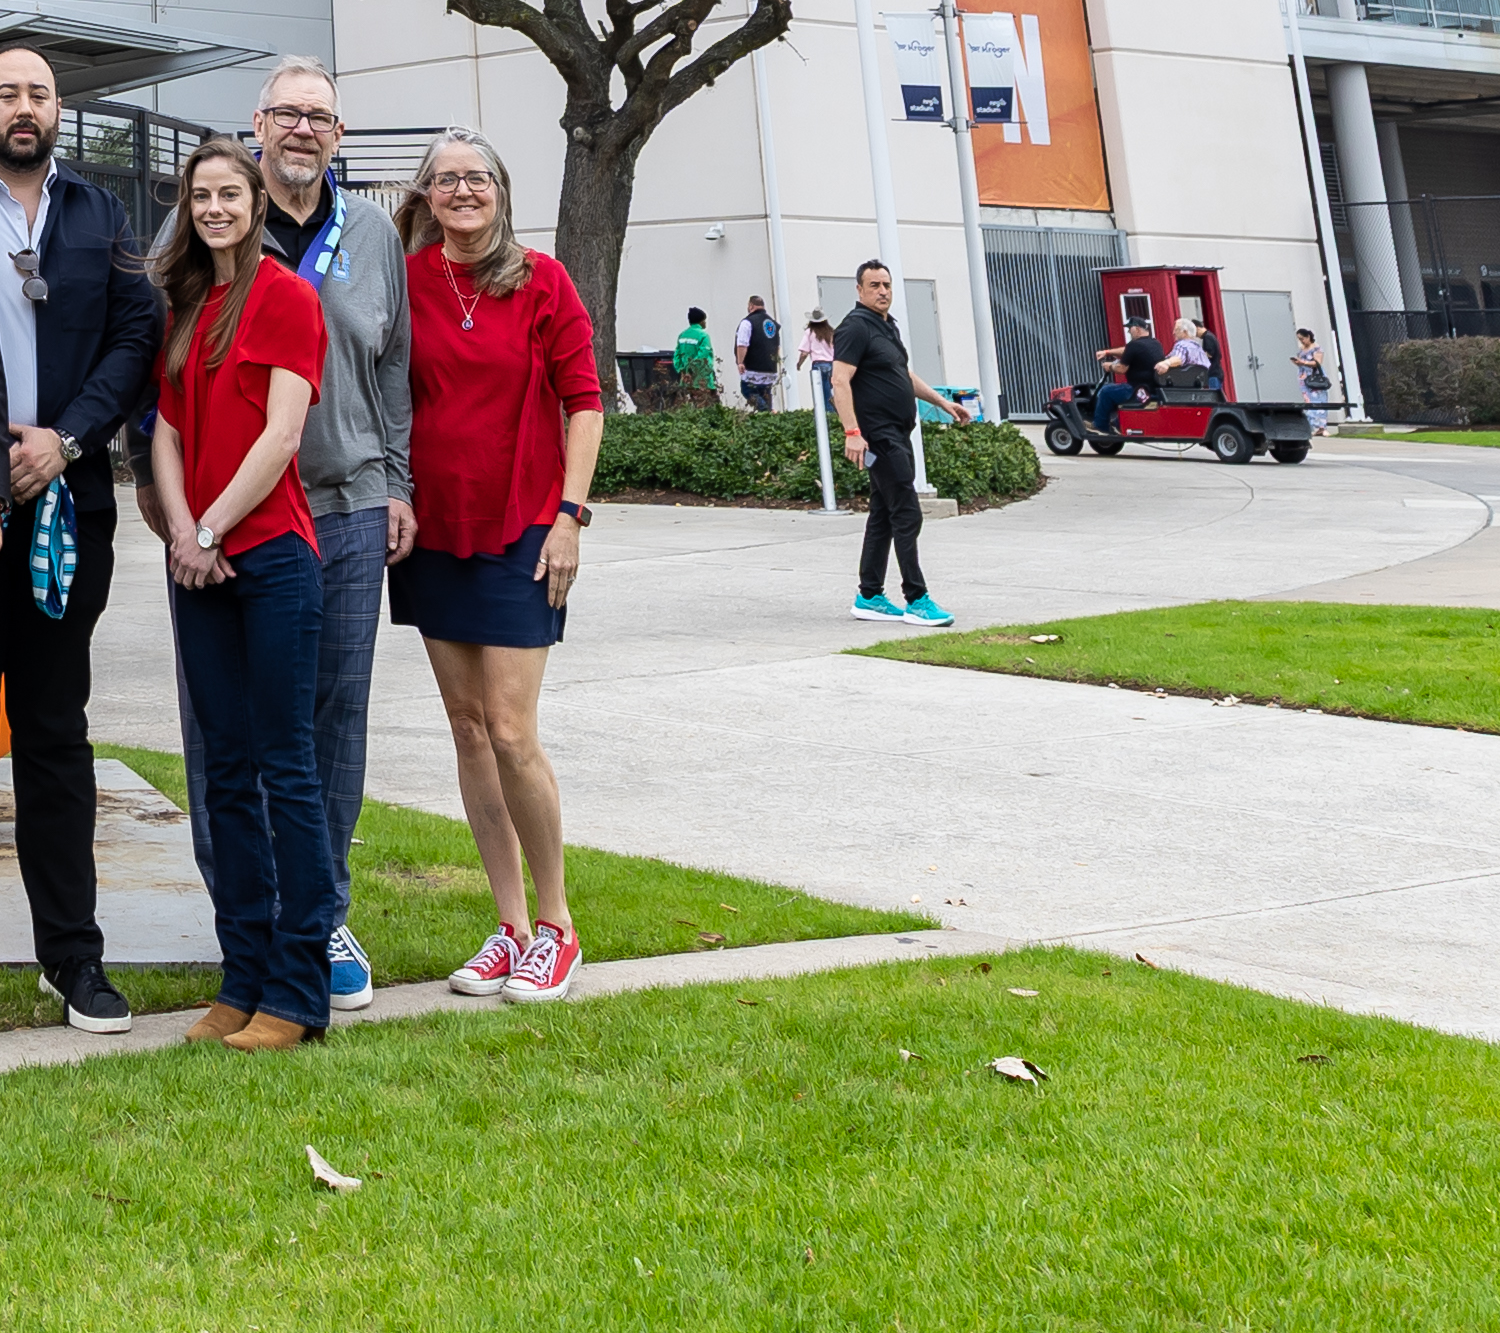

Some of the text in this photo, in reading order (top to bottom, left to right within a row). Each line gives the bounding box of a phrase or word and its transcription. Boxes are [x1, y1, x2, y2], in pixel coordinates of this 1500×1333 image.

[908, 40, 935, 57] Kroger
[982, 41, 1011, 58] Kroger
[909, 104, 934, 112] stadium
[976, 105, 1001, 113] stadium
